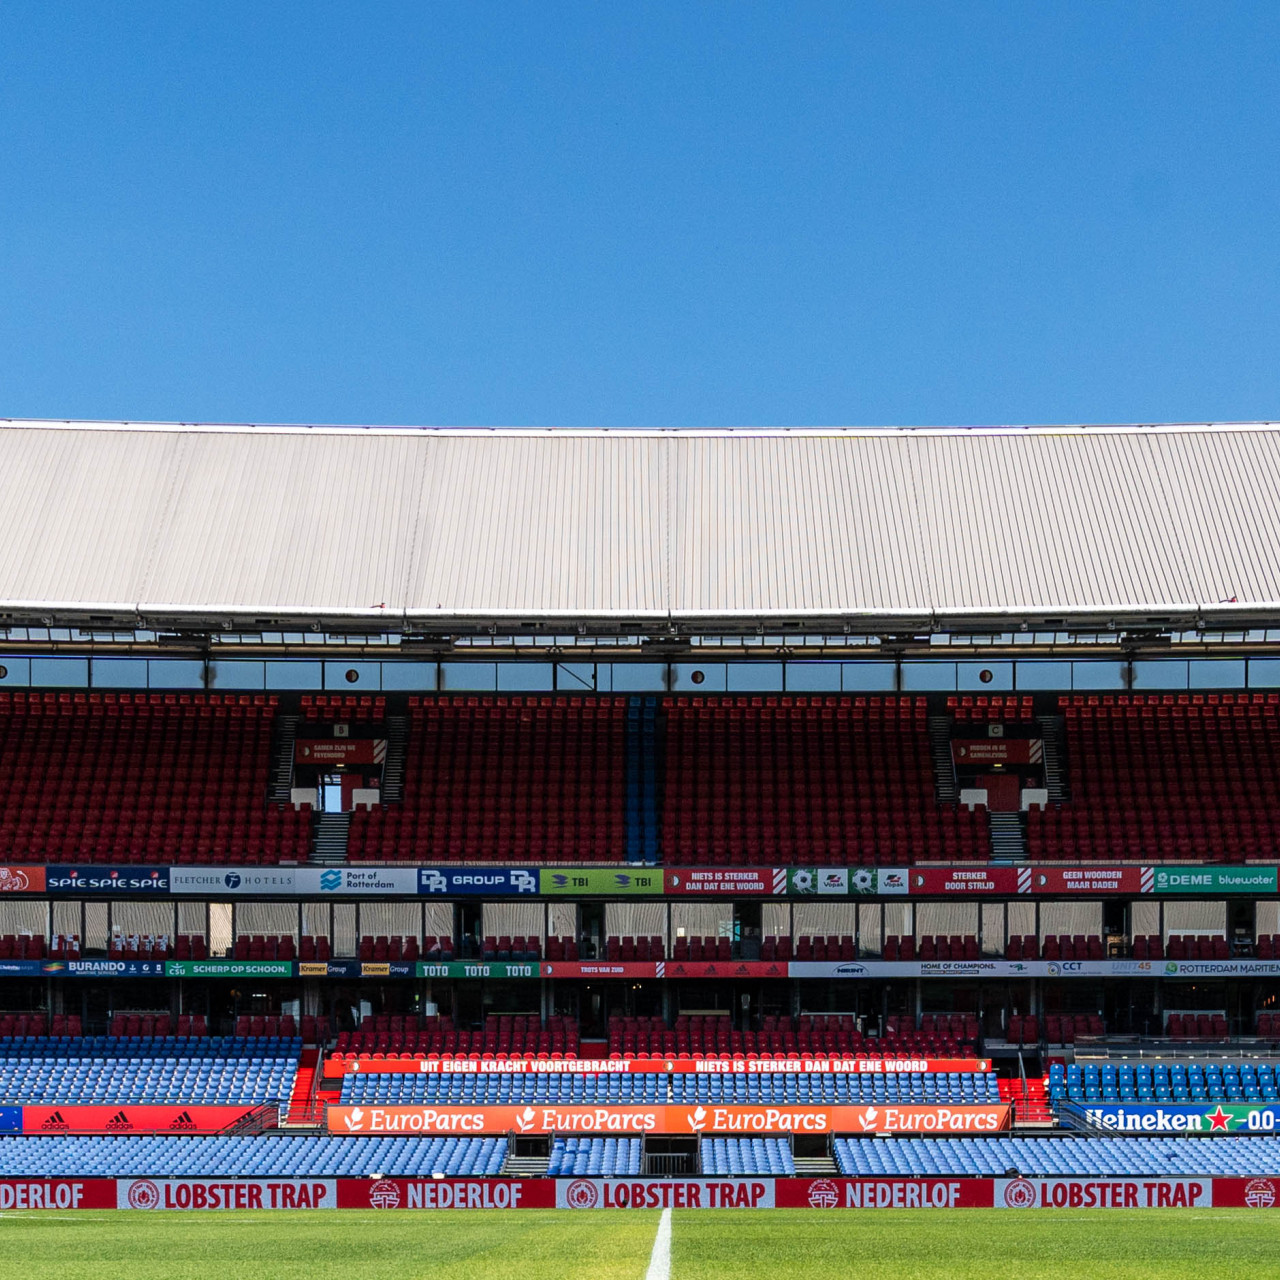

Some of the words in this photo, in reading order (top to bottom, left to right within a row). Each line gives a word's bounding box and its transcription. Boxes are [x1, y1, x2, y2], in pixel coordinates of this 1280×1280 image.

[347, 872, 364, 880] Port
[368, 872, 377, 880] of
[691, 872, 712, 880] NIETS
[714, 872, 722, 880] IS
[724, 872, 758, 880] STERKER
[952, 872, 987, 880] STERKER
[1062, 871, 1083, 879] GEEN
[1084, 871, 1122, 879] WOORDEN
[1170, 874, 1212, 884] DEME
[1218, 874, 1274, 885] bluewater
[48, 878, 86, 888] SPIE
[89, 878, 126, 888] SPIE
[130, 878, 167, 888] SPIE
[174, 876, 220, 884] FLETCHER
[245, 876, 292, 884] HOTELS
[346, 880, 394, 889] Rotterdam
[572, 878, 588, 887] TBI
[634, 878, 651, 887] TBI
[1066, 880, 1089, 889] MAAR
[1091, 880, 1118, 889] DADEN
[686, 882, 702, 891] DAN
[704, 882, 718, 891] DAT
[721, 882, 735, 891] ENE
[737, 882, 764, 891] WOORD
[945, 882, 966, 890] DOOR
[968, 882, 994, 890] STRIJD
[68, 962, 126, 971] BURANDO
[192, 965, 230, 973] SCHERP
[230, 965, 242, 973] OP
[242, 965, 288, 973] SCHOON.
[300, 965, 326, 973] Kramer
[328, 966, 347, 974] Group
[1062, 962, 1082, 970] CCT
[1111, 962, 1152, 970] UNIT45
[1180, 964, 1238, 974] ROTTERDAM
[169, 968, 186, 976] CSU
[422, 966, 448, 976] TOTO
[420, 1060, 440, 1072] UIT
[442, 1060, 478, 1072] EIGEN
[480, 1060, 528, 1072] KRACHT
[530, 1060, 630, 1072] VOORTGEBRACHT
[696, 1060, 730, 1072] NIETS
[732, 1060, 745, 1072] IS
[748, 1060, 802, 1072] STERKER
[804, 1060, 829, 1072] DAN
[832, 1060, 856, 1072] DAT
[858, 1060, 882, 1072] ENE
[885, 1060, 928, 1072] WOORD
[370, 1110, 484, 1130] EuroParcs
[541, 1110, 656, 1130] EuroParcs
[712, 1110, 827, 1130] EuroParcs
[884, 1110, 998, 1130] EuroParcs
[1085, 1109, 1202, 1131] Heineken
[40, 1122, 70, 1130] adidas
[104, 1122, 134, 1130] adidas
[169, 1122, 198, 1130] adidas
[164, 1184, 262, 1208] LOBSTER
[265, 1184, 326, 1208] TRAP
[406, 1184, 522, 1209] NEDERLOF
[602, 1183, 702, 1208] LOBSTER
[704, 1183, 765, 1208] TRAP
[846, 1183, 960, 1208] NEDERLOF
[1040, 1182, 1138, 1208] LOBSTER
[1142, 1182, 1203, 1207] TRAP
